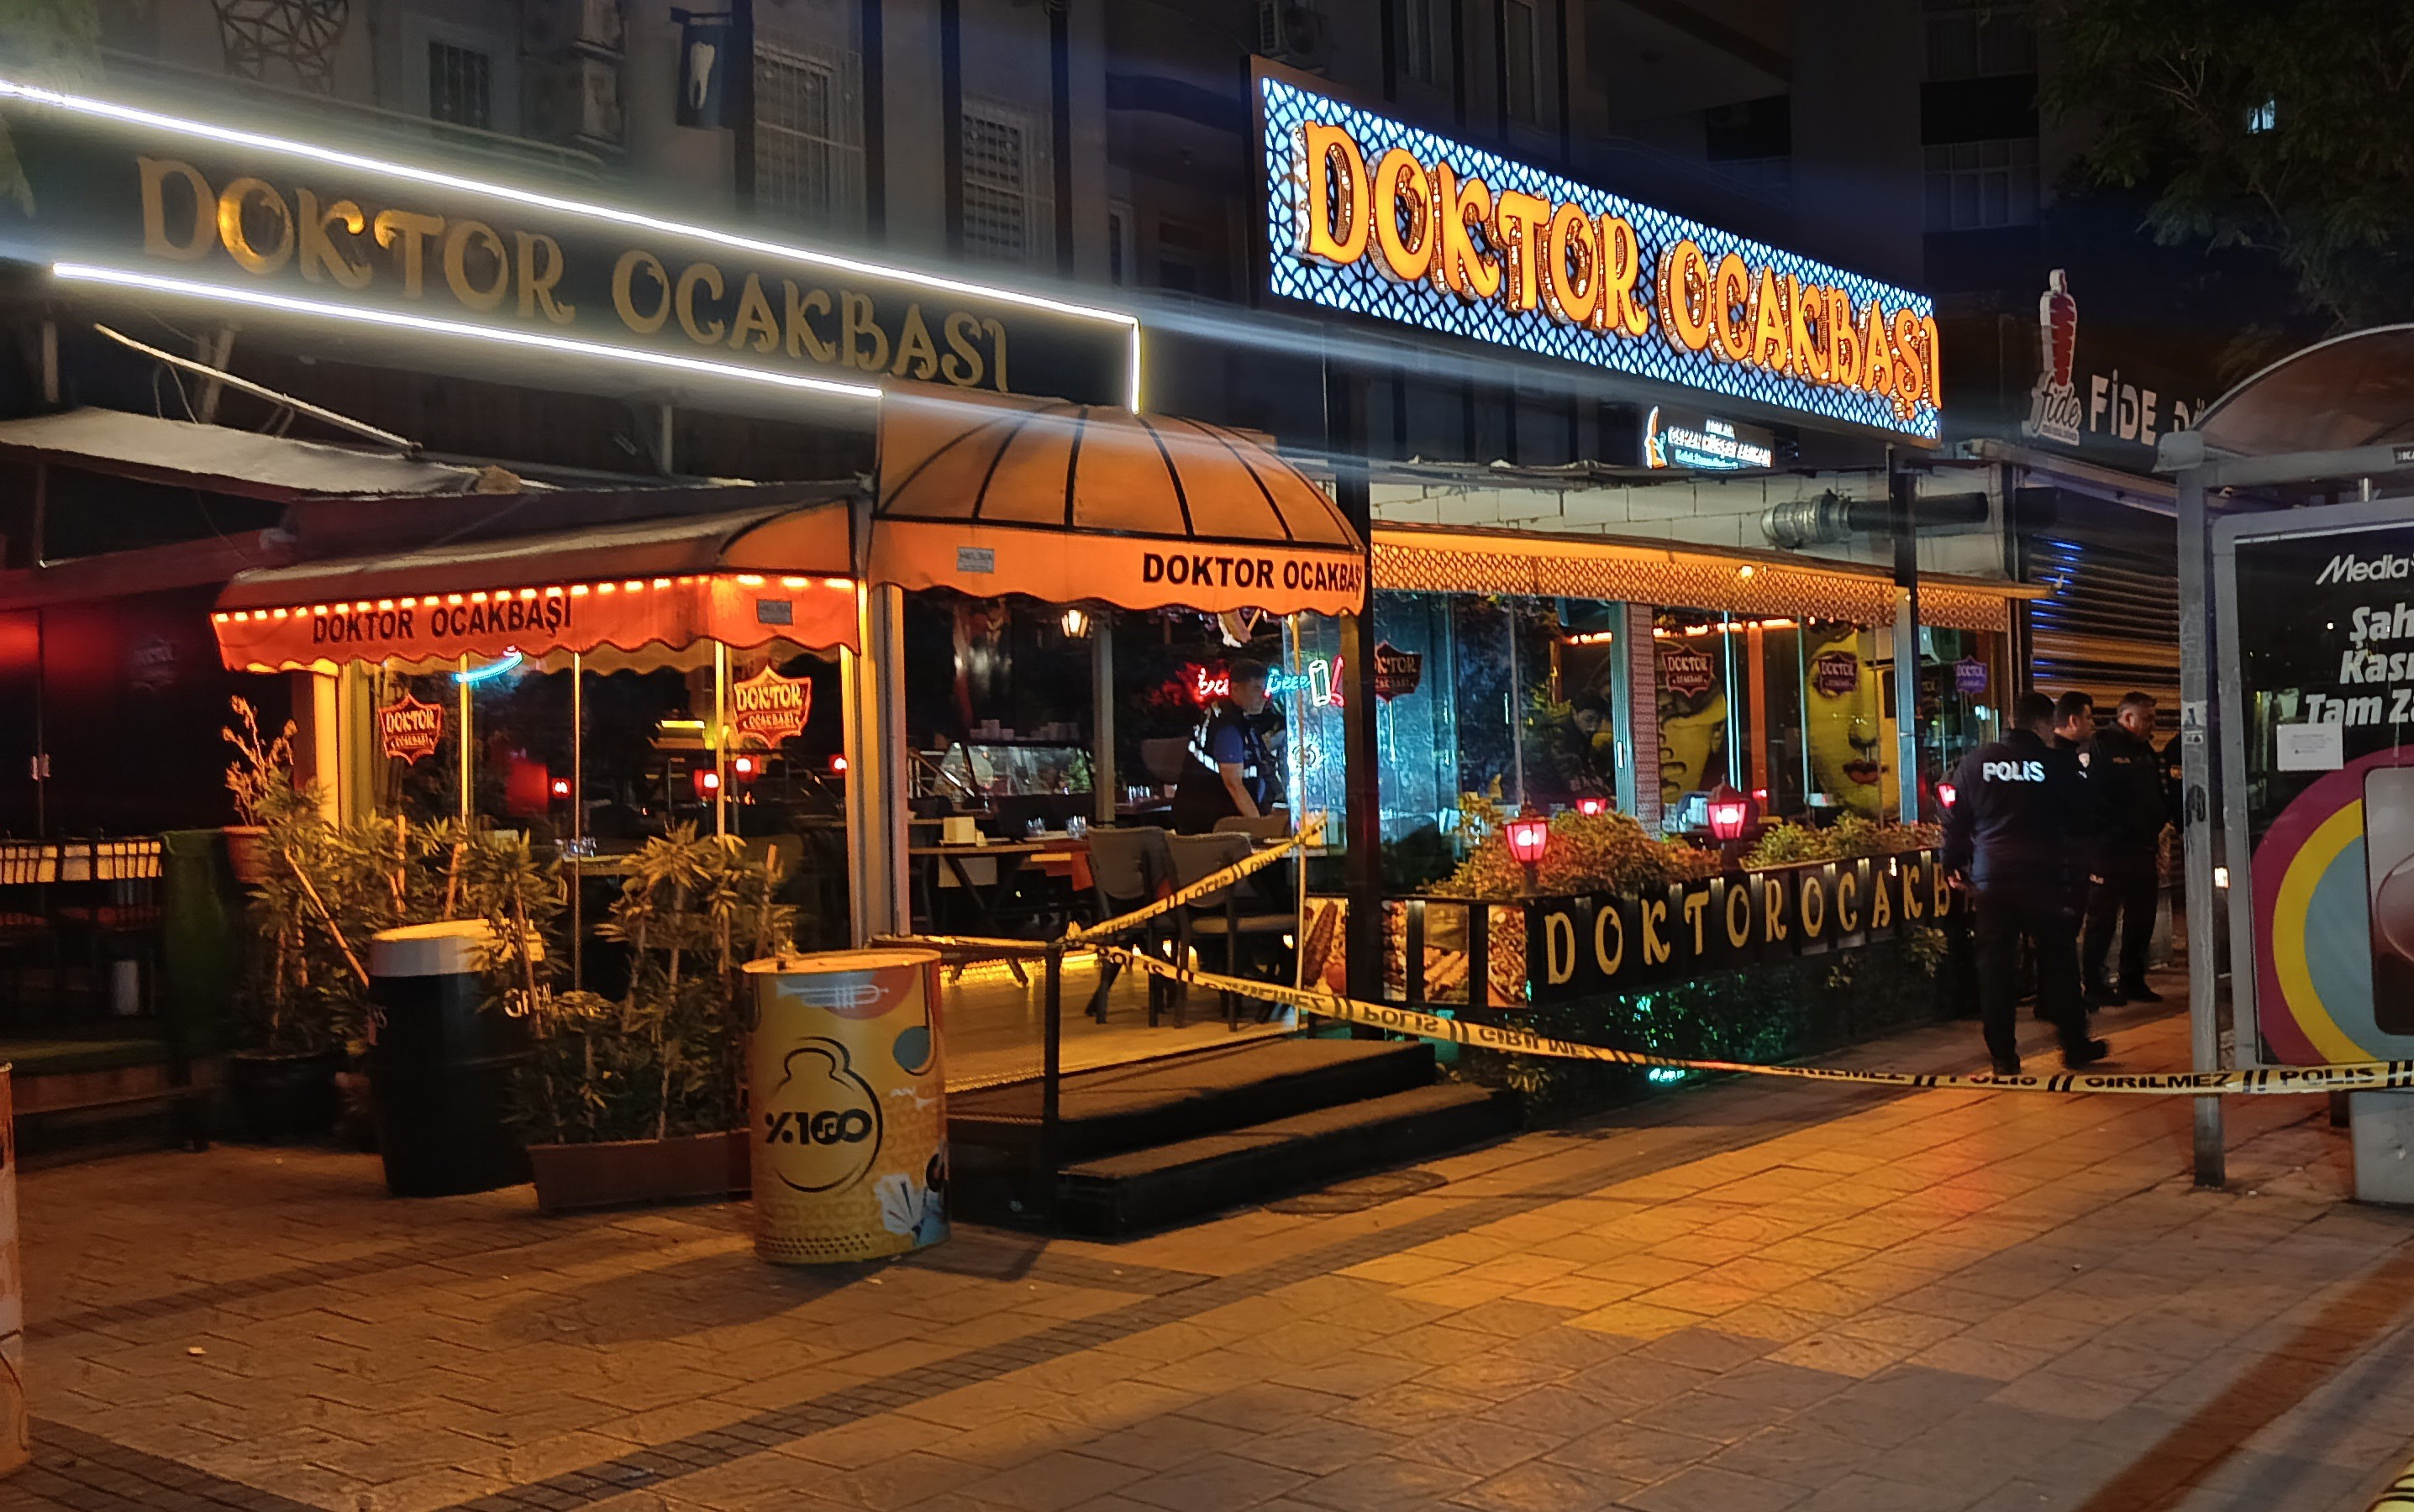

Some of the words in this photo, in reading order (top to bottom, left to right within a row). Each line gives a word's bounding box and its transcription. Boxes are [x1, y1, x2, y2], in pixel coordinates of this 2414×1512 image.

[138, 156, 576, 326] DOKTOR
[1299, 120, 1648, 337] DOKTOR
[1664, 239, 1943, 420] OCAKBAŞI
[1143, 552, 1274, 590] DOKTOR
[313, 608, 415, 644] DOKTOR
[431, 596, 571, 638] OCAKBAŞI
[735, 683, 803, 711] DOKTOR
[2306, 693, 2383, 727] Tam
[2389, 688, 2414, 723] Z
[386, 709, 435, 733] DOKTOR
